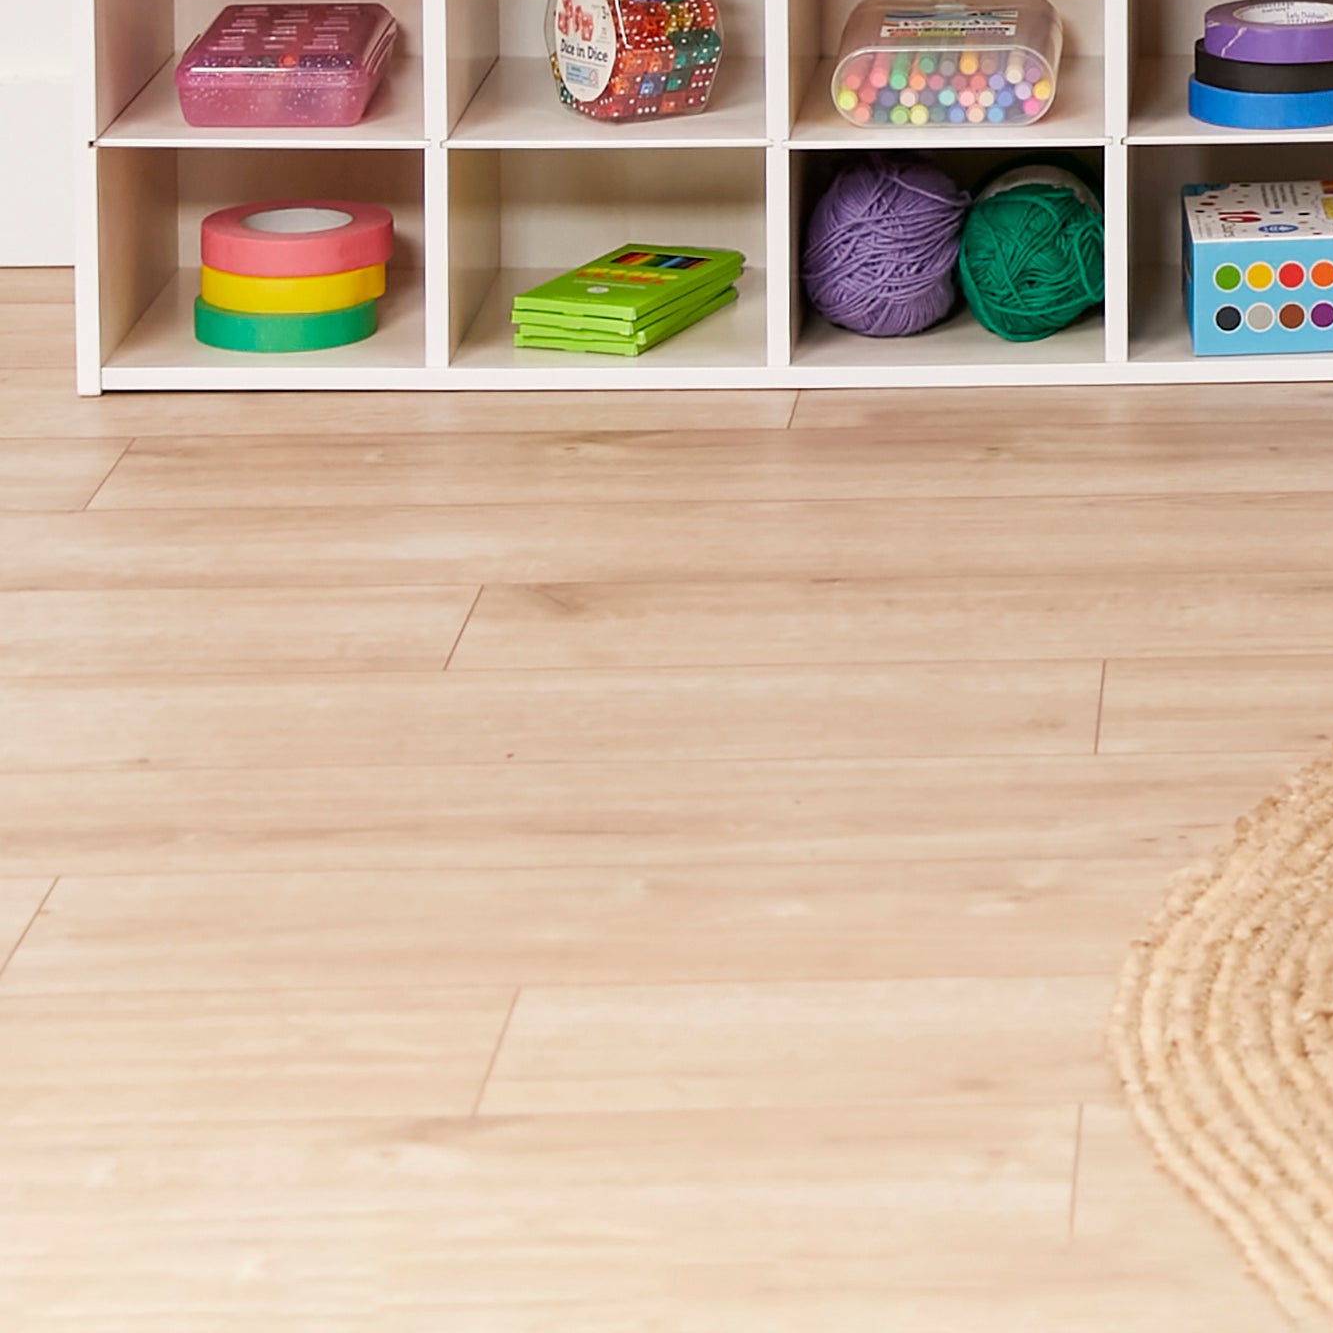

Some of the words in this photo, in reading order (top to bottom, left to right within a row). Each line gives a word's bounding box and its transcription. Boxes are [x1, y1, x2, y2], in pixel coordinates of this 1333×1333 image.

[561, 38, 575, 54] Dice
[576, 43, 586, 58] in
[587, 45, 609, 62] Dice
